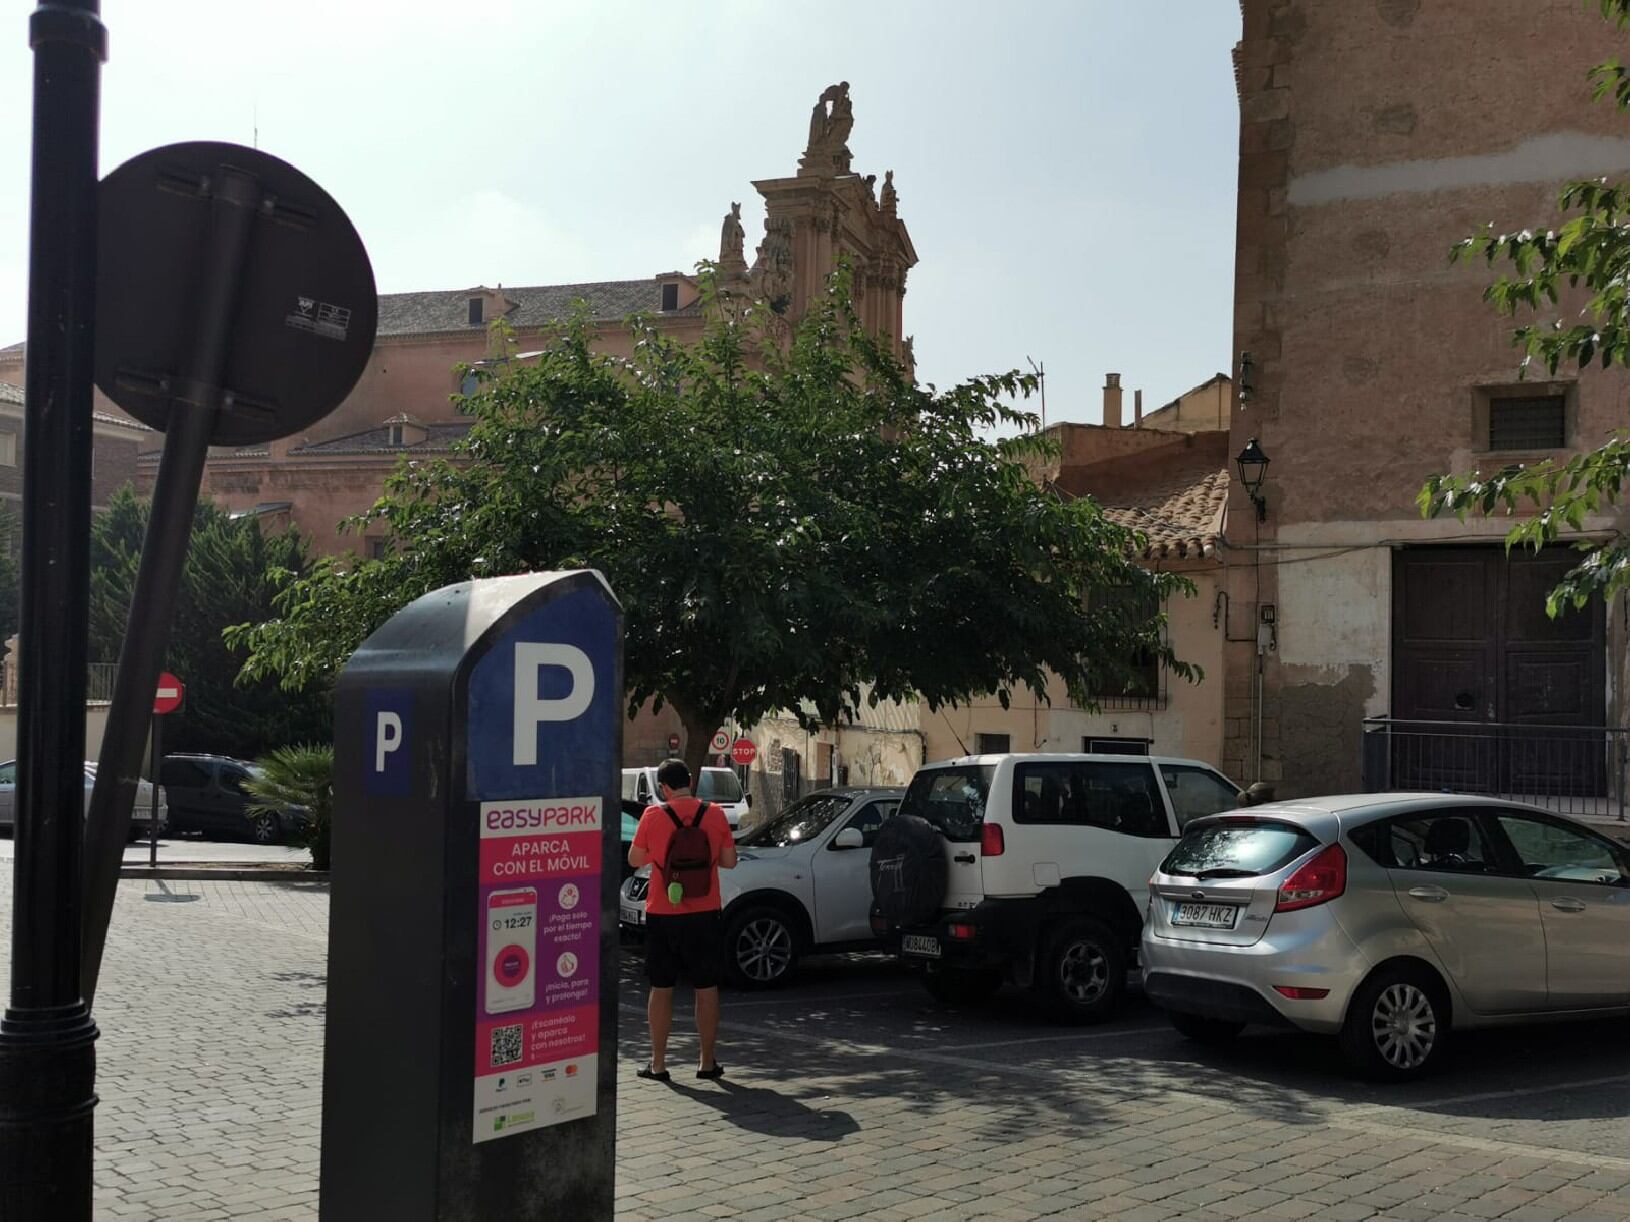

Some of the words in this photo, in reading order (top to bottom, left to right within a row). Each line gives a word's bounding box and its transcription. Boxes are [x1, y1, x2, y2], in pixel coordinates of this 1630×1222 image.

[512, 642, 595, 766] P
[375, 711, 403, 772] P
[716, 737, 724, 745] 10
[732, 748, 756, 756] STOP
[511, 839, 570, 857] APARCA
[493, 860, 526, 876] CON
[529, 859, 543, 873] EL
[547, 853, 590, 872] MÓVIL
[572, 911, 588, 919] solo
[1180, 905, 1207, 921] 3087
[1209, 906, 1233, 923] HKZ
[505, 916, 532, 928] 12:27
[543, 926, 556, 935] por
[558, 923, 565, 931] el
[537, 1027, 568, 1040] aparca
[531, 1041, 548, 1051] con
